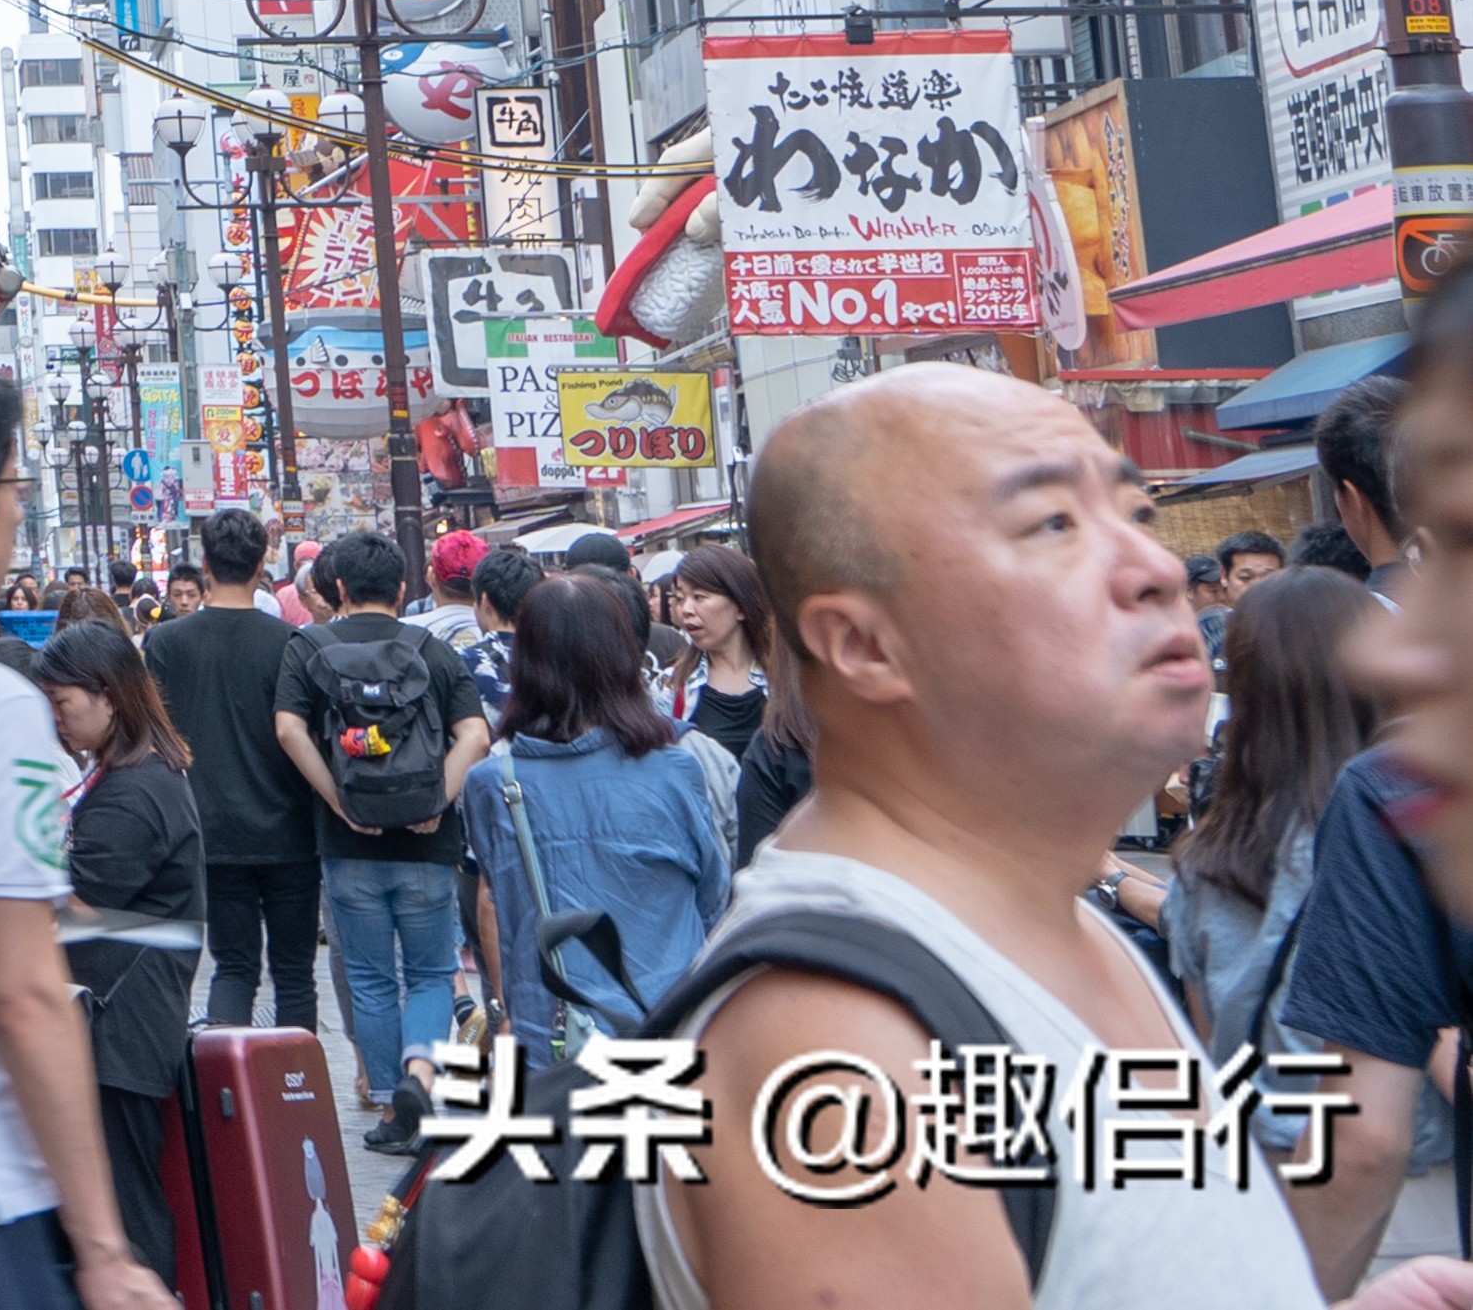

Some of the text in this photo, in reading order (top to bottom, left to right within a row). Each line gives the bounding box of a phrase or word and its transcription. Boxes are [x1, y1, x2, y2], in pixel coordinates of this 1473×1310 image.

[767, 67, 963, 115] たこ焼道楽
[496, 106, 539, 135] 牛角
[725, 104, 1019, 214] わなか
[730, 252, 945, 277] 千日前で愛されて半世紀
[731, 281, 785, 300] 大阪で
[733, 279, 957, 325] 人気 No.1 やで!
[963, 303, 1029, 320] 2015年
[508, 333, 595, 343] ITALIAN RESTAURANT
[497, 365, 559, 393] PAS
[561, 378, 624, 391] Fishing Pond
[570, 425, 706, 461] つりぼり
